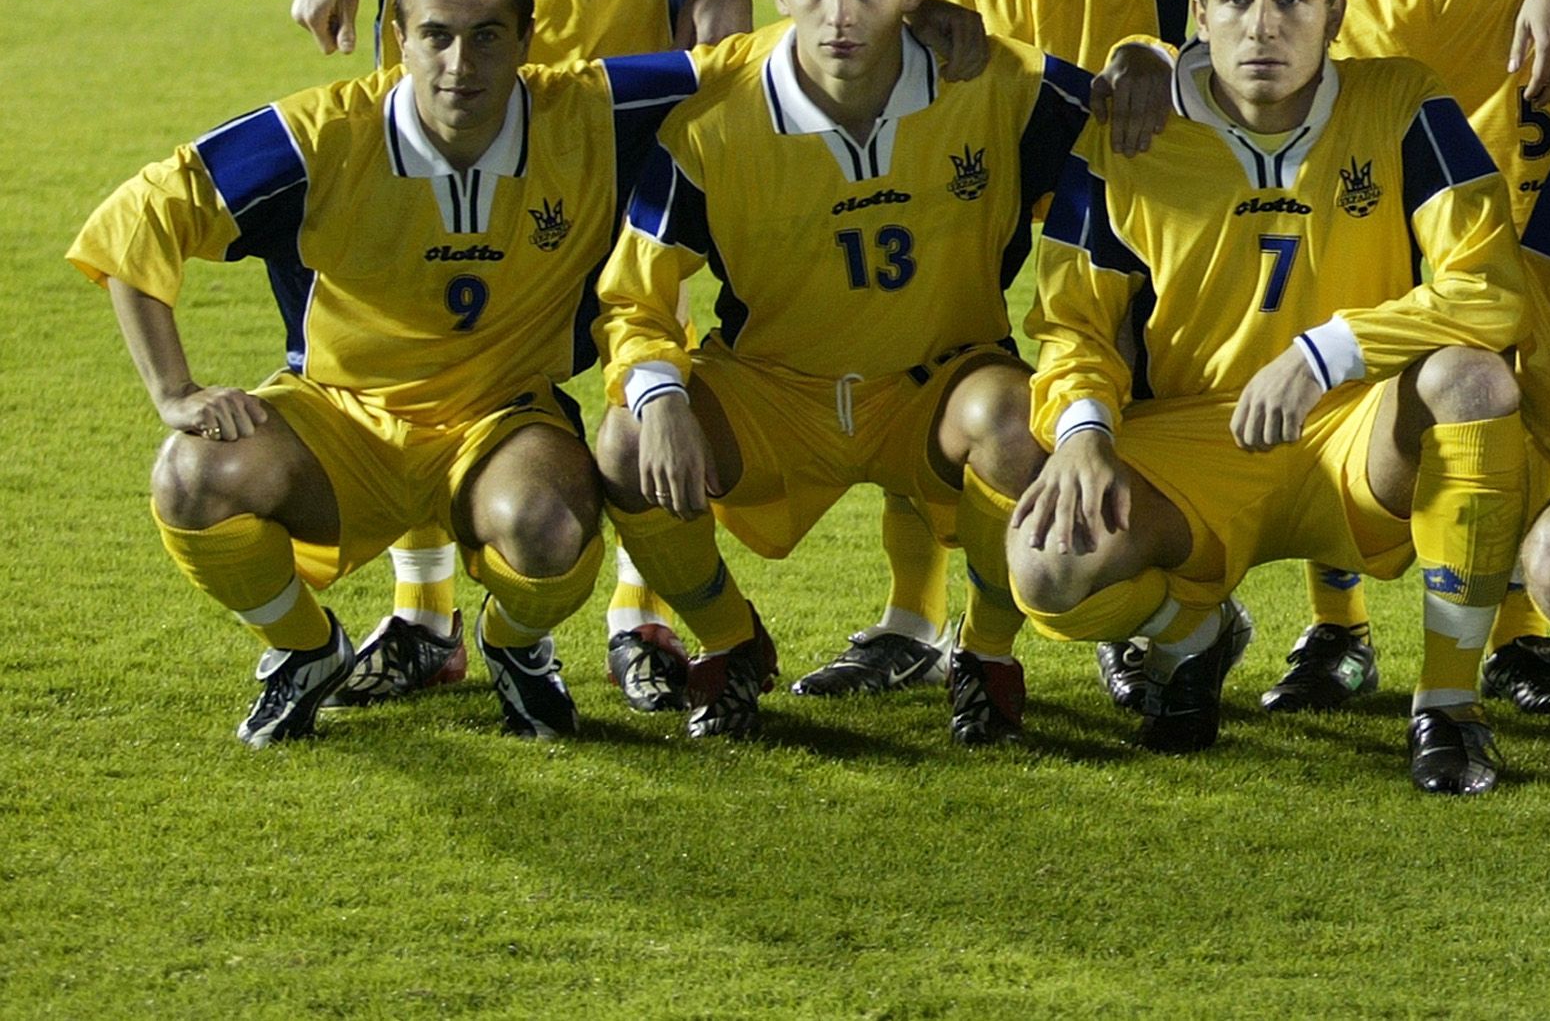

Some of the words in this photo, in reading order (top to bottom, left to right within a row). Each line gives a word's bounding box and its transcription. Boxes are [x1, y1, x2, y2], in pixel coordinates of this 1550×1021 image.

[848, 189, 912, 211] lotto
[1250, 197, 1312, 215] lotto
[441, 245, 504, 262] lotto
[835, 224, 917, 292] 13
[1258, 234, 1301, 314] 7
[444, 274, 489, 334] 9
